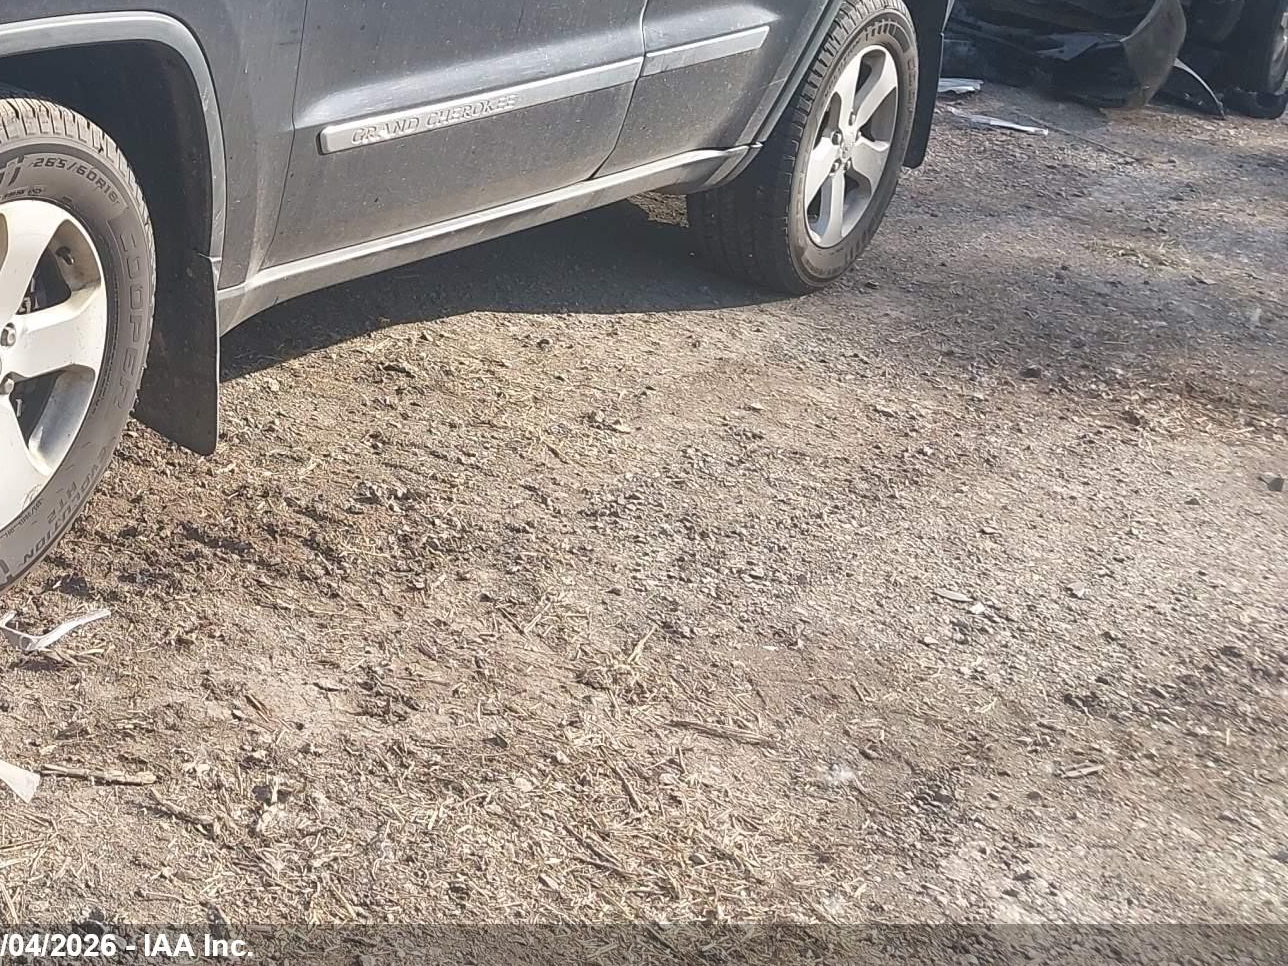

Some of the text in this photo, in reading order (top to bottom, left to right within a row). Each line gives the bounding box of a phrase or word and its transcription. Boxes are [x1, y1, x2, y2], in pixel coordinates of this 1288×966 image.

[351, 94, 517, 144] GRAND CHEROKEE
[113, 234, 144, 410] COOPER
